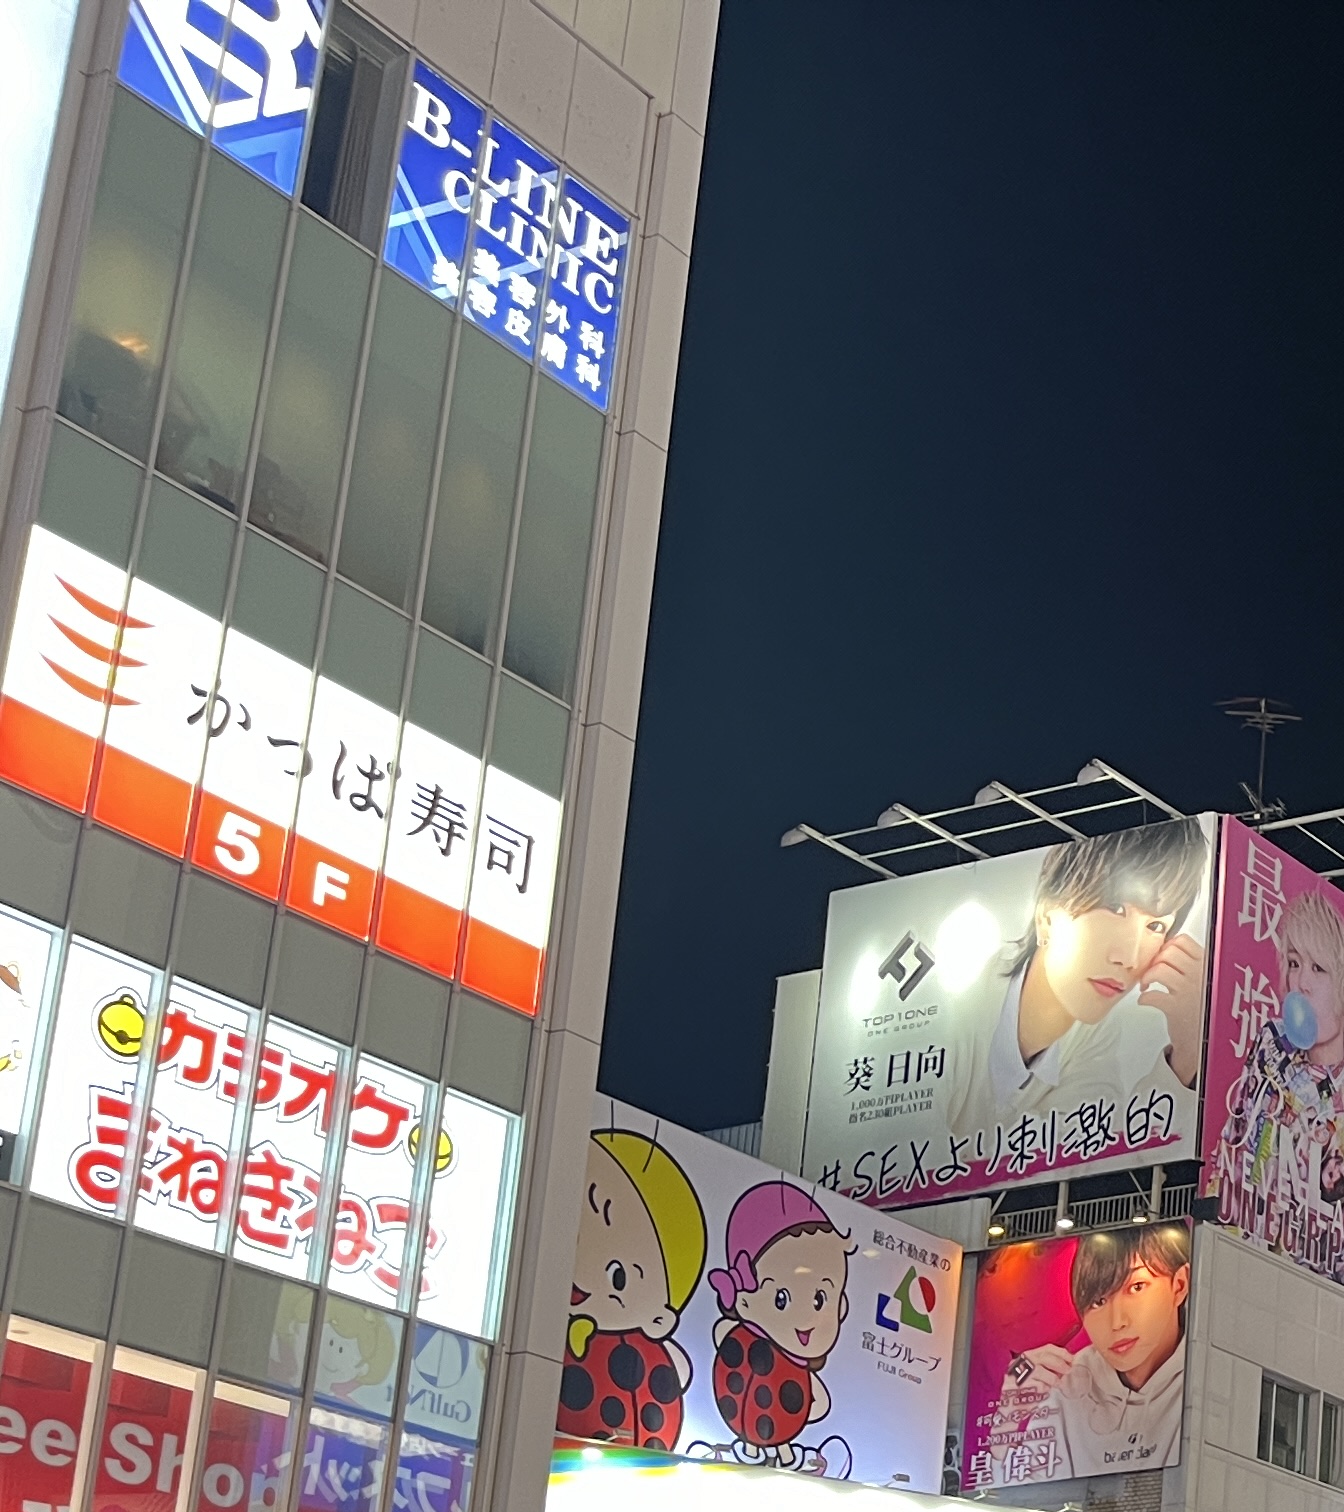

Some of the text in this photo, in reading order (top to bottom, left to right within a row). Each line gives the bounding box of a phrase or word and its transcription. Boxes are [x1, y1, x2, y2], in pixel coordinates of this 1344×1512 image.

[408, 82, 619, 277] B-LINE
[444, 168, 613, 315] CLINIC
[187, 679, 534, 895] かっぱ寿司
[157, 1009, 413, 1149] カラオケ
[843, 1045, 946, 1096] 葵 日向
[76, 1093, 441, 1295] まねきねこ
[873, 1229, 951, 1271] 総合不動産業の
[862, 1331, 941, 1371] 富士グループ
